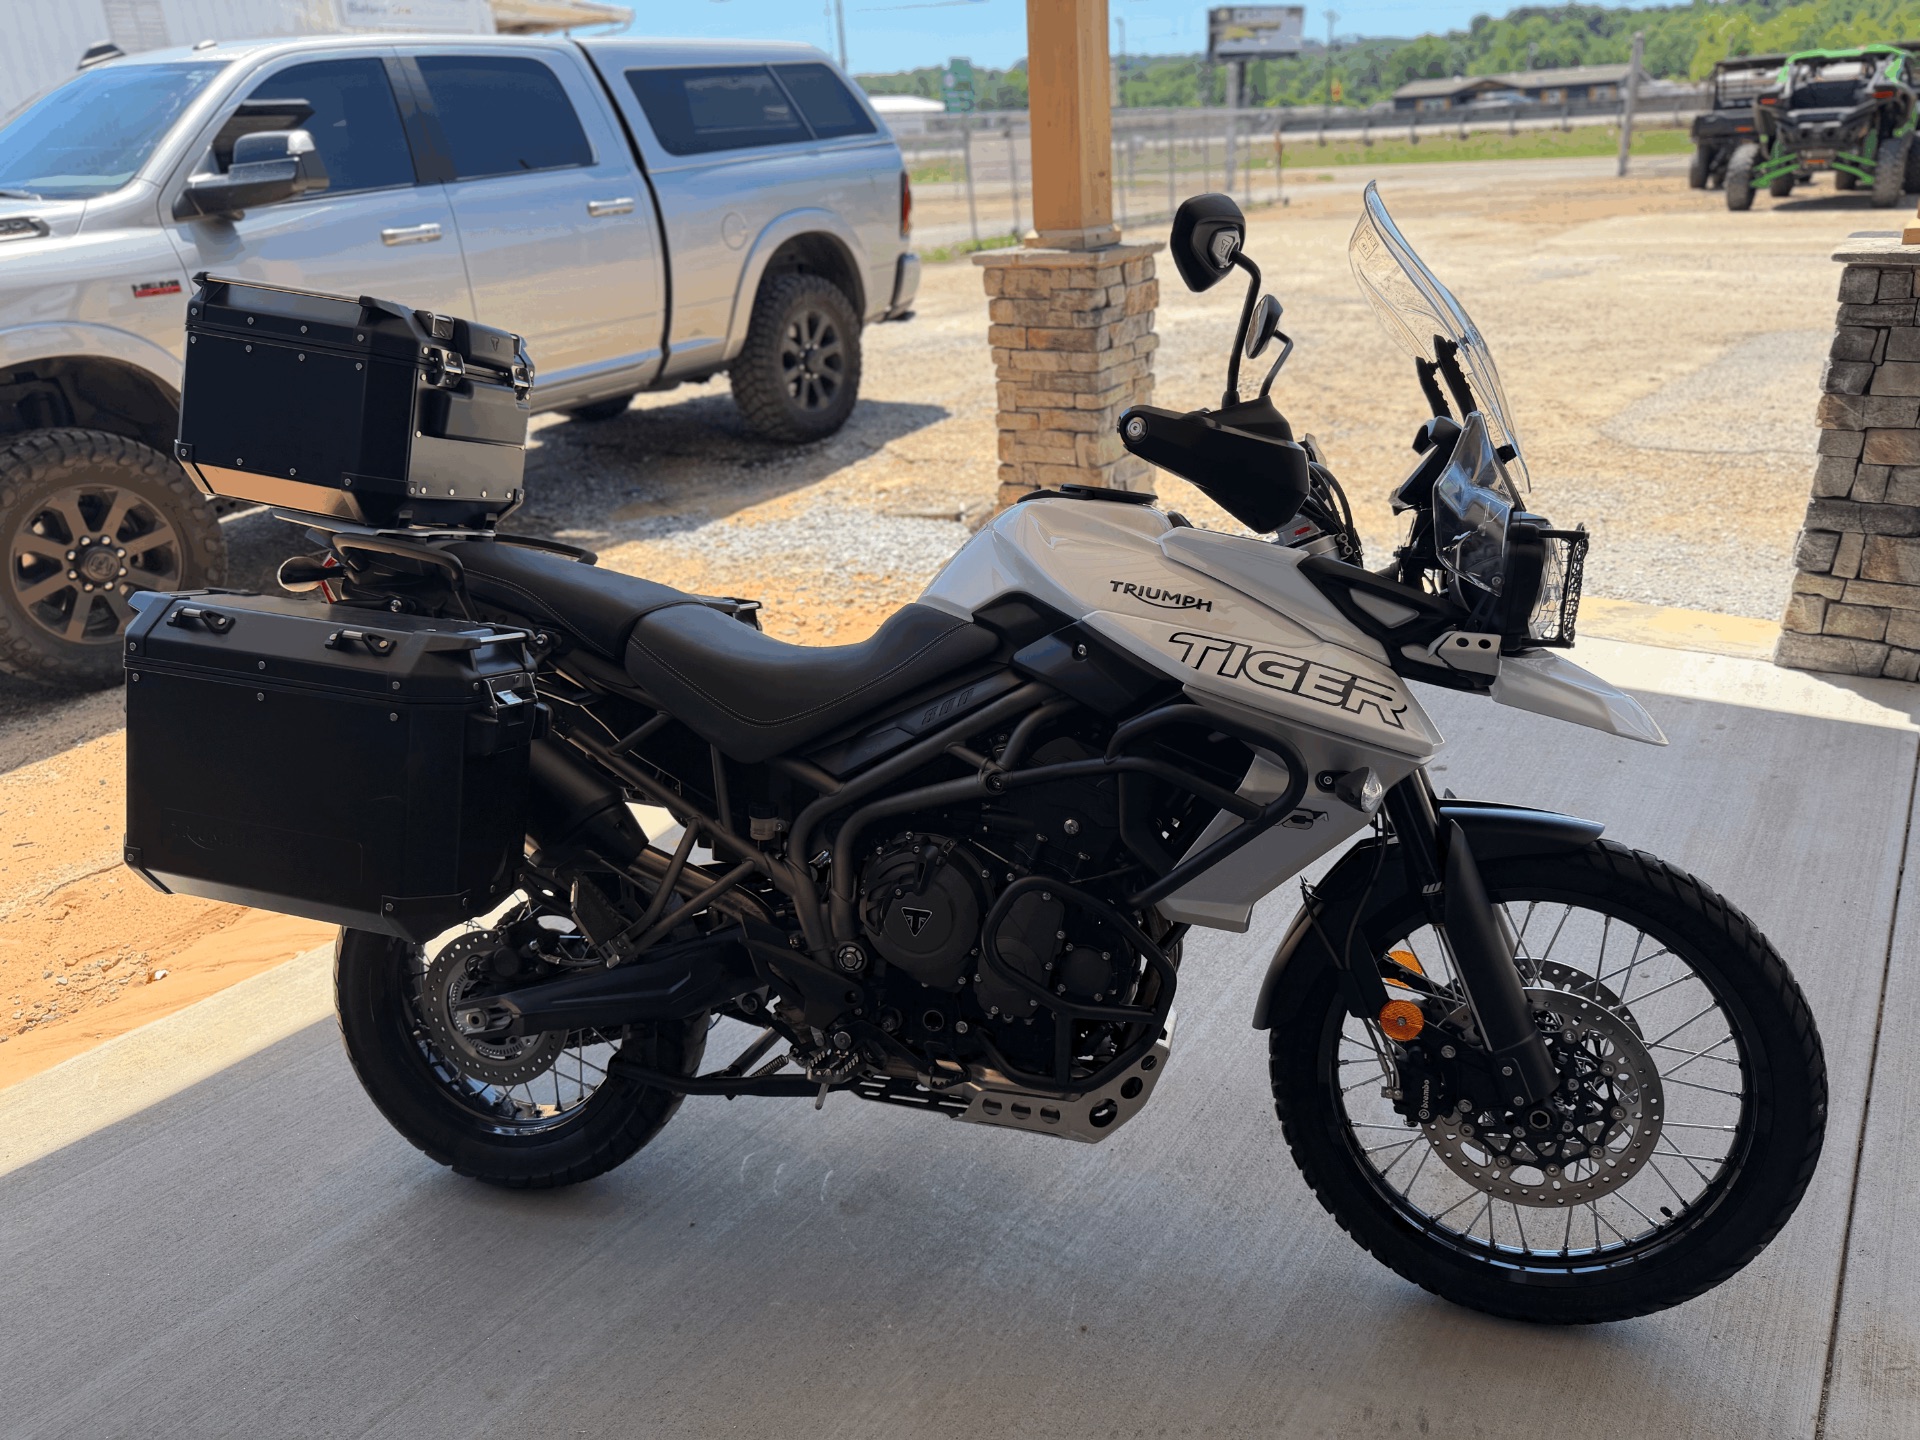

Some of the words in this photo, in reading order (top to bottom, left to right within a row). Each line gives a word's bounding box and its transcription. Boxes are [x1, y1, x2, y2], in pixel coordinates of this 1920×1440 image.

[1110, 580, 1212, 612] TRIUMPH
[1168, 631, 1408, 730] TIGER
[1420, 1079, 1430, 1109] brembo
